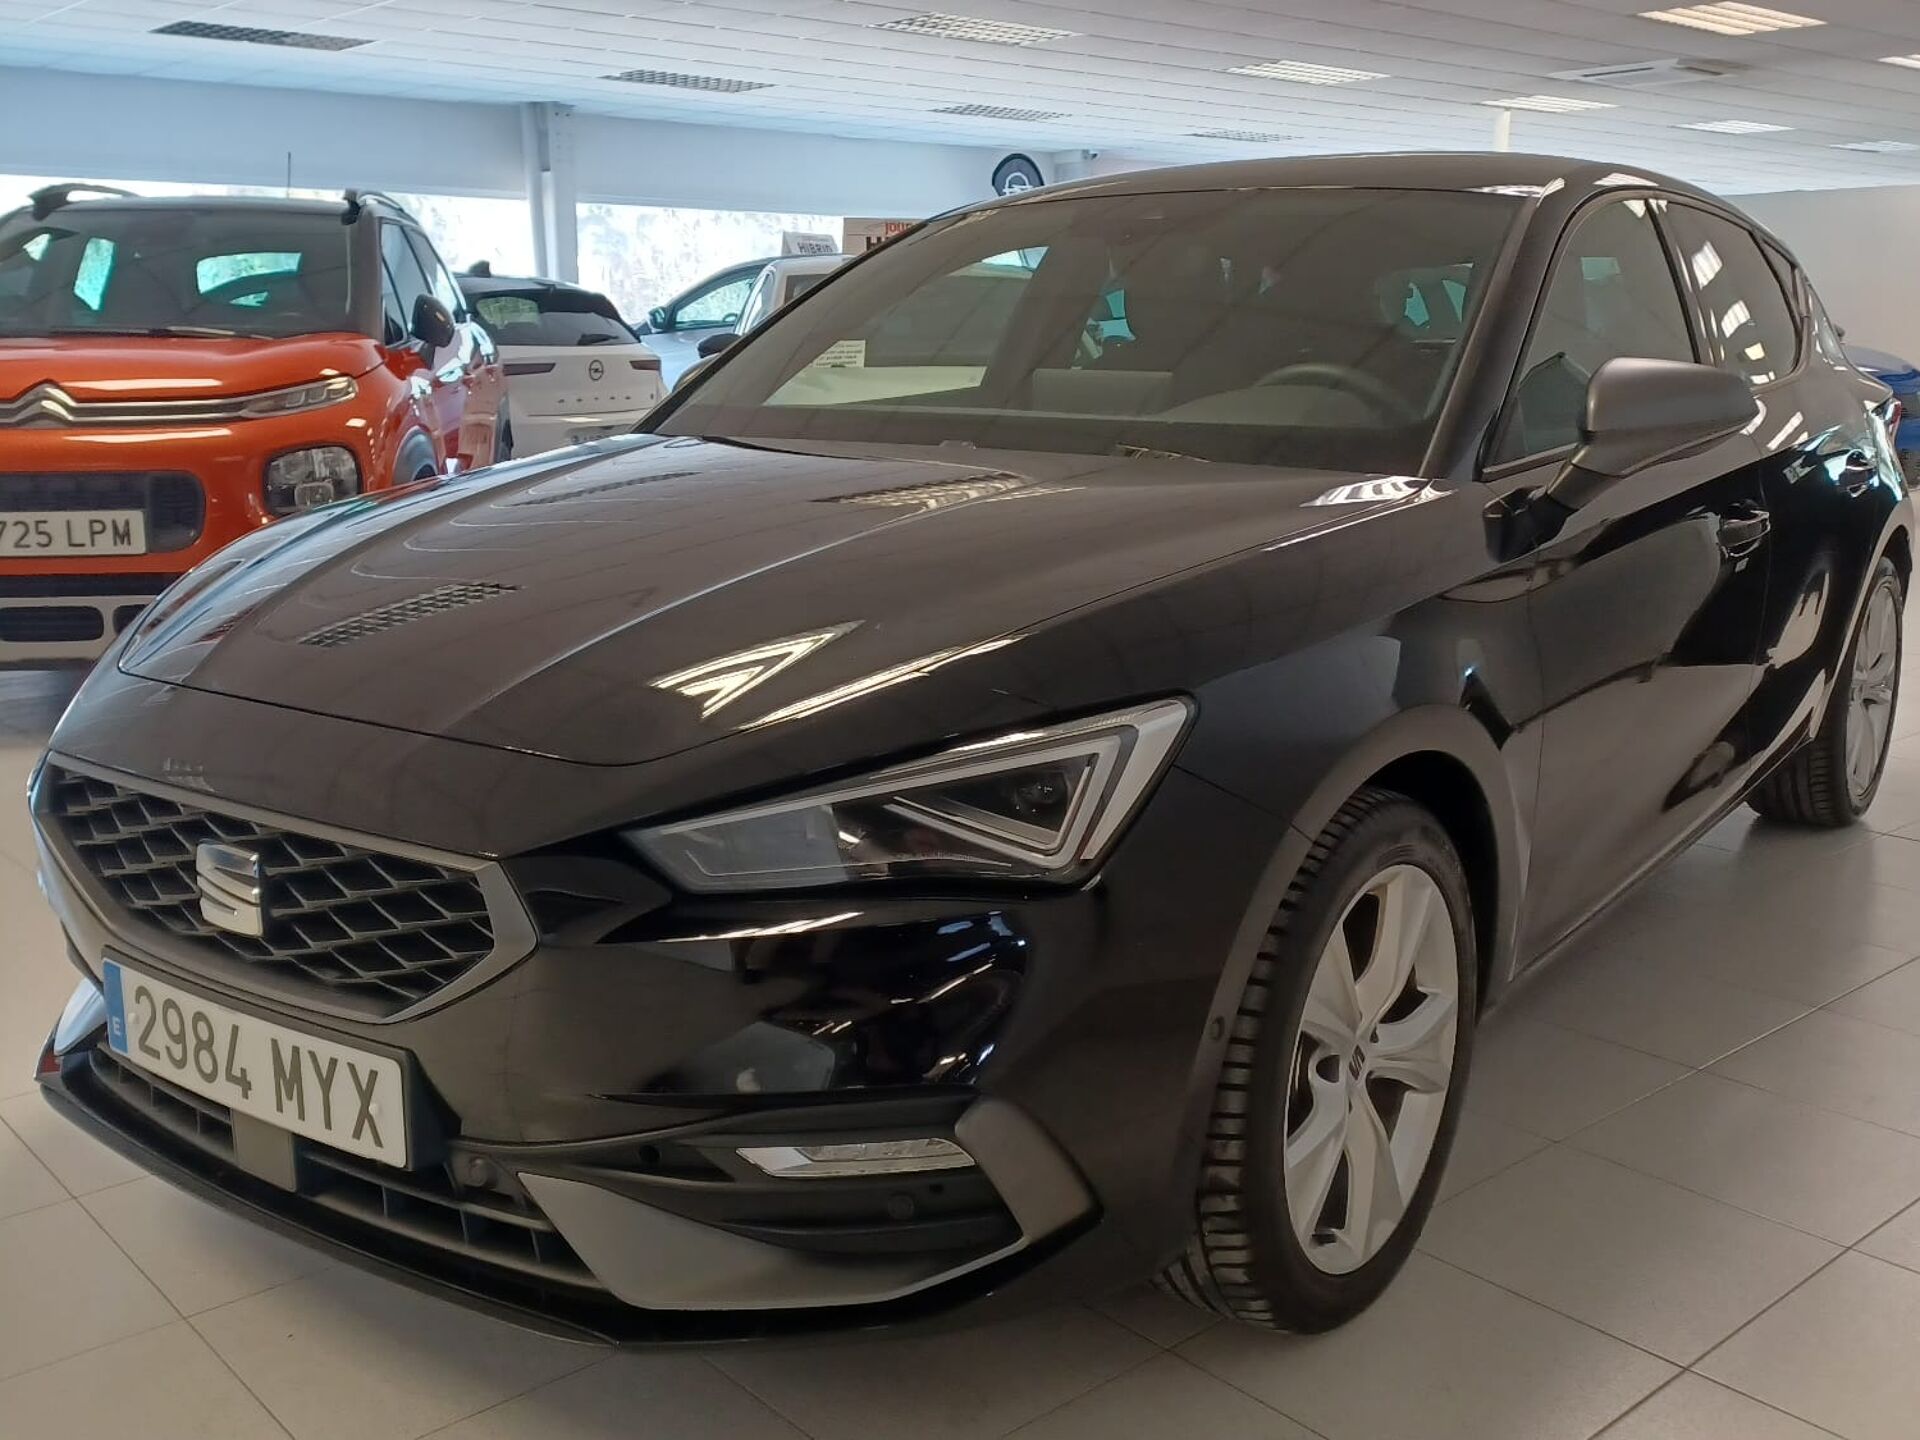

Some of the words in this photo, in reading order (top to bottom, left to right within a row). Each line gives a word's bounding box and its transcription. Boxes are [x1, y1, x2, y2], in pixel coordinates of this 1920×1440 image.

[66, 519, 132, 547] LPM
[113, 1015, 122, 1035] E
[135, 985, 252, 1100] 2984
[270, 1038, 385, 1148] MYX
